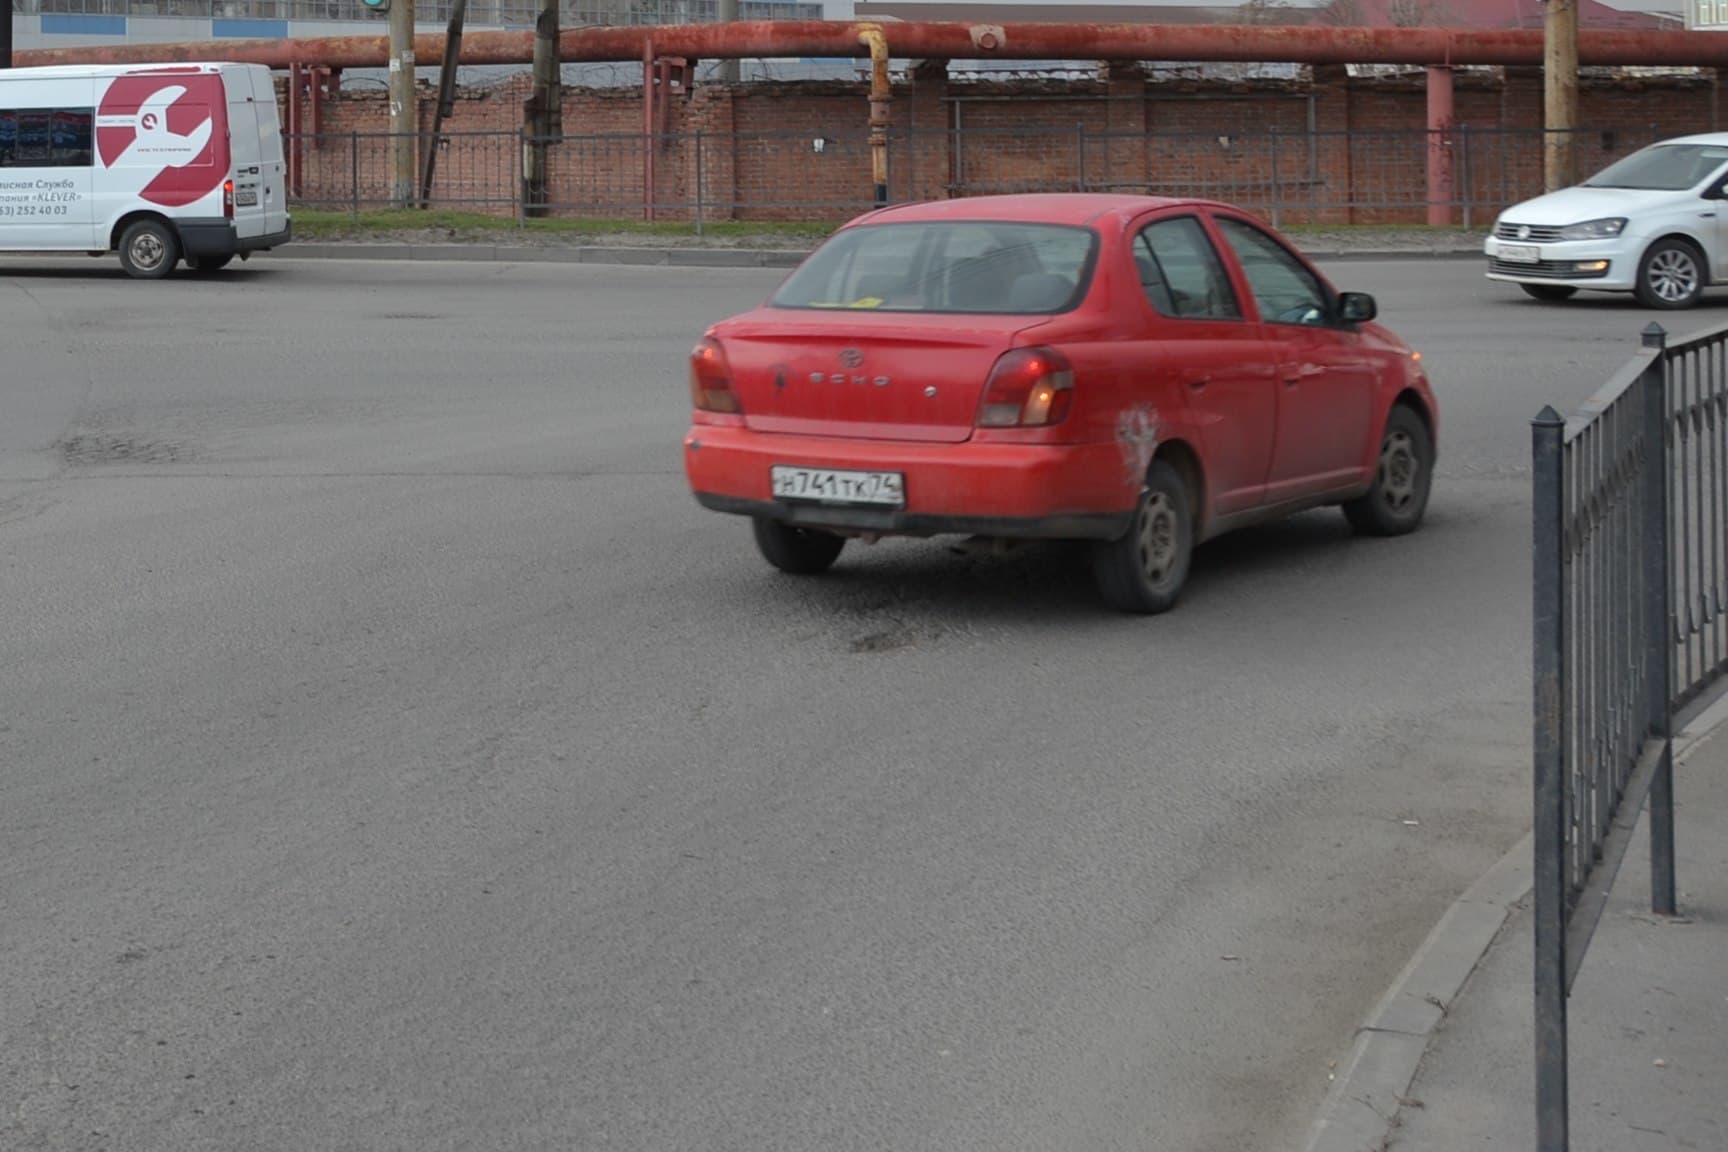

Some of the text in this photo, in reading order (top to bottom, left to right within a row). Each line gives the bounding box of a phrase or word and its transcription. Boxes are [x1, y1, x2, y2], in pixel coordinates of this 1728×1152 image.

[35, 178, 74, 191] Служба
[16, 206, 36, 216] 252
[38, 206, 52, 215] 40
[54, 206, 68, 215] 03
[809, 372, 890, 387] ECHO
